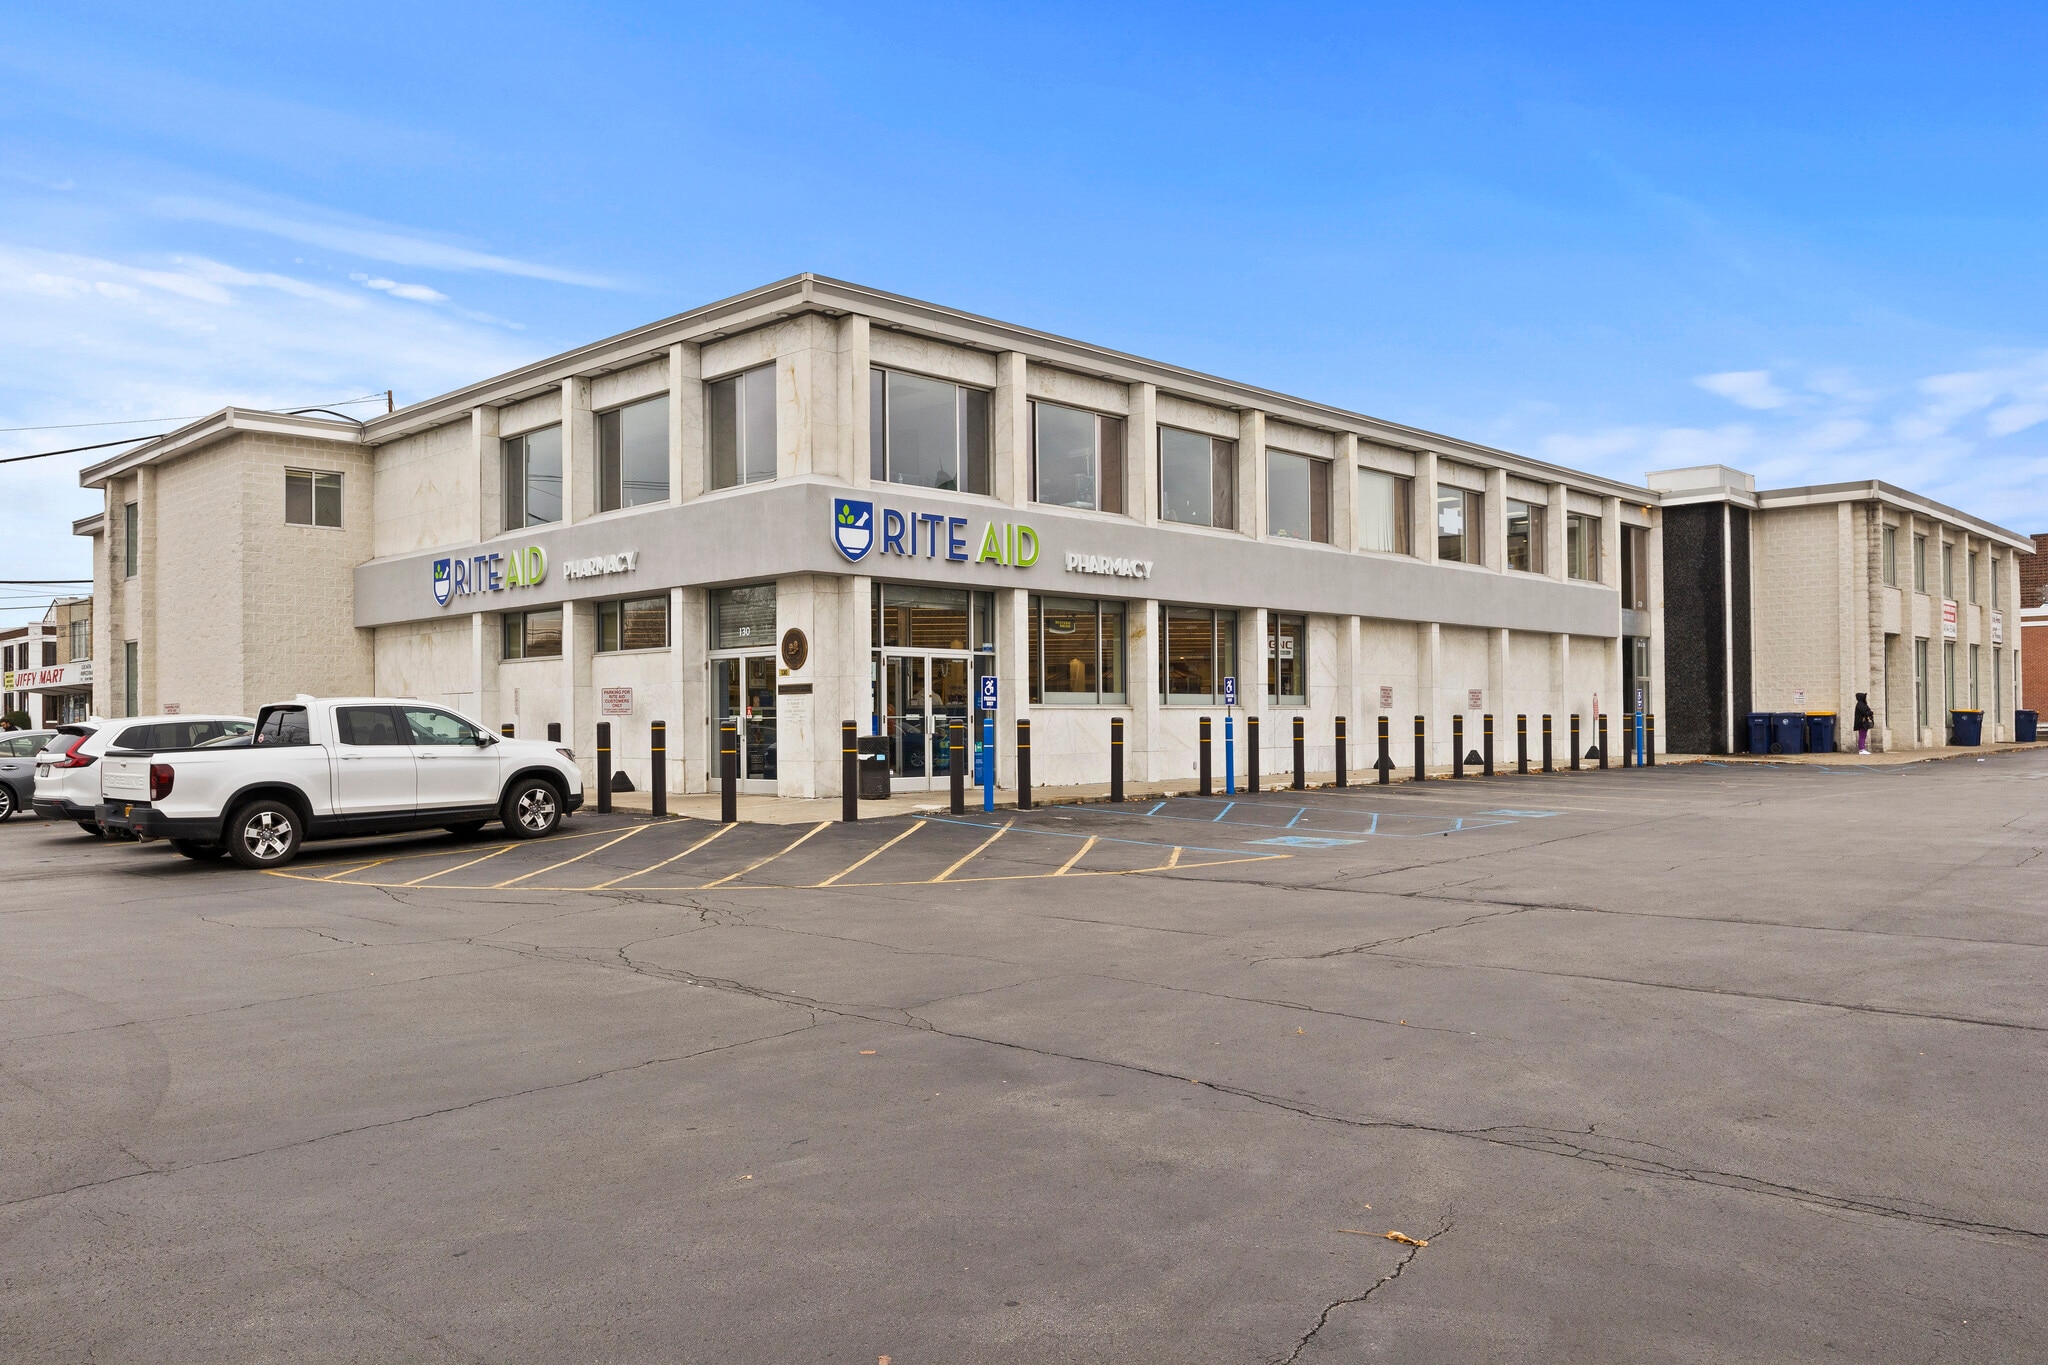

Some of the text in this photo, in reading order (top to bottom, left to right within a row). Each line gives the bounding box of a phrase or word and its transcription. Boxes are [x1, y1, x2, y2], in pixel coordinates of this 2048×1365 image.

[882, 508, 1040, 567] RITE AID
[454, 546, 547, 595] RITE AID
[563, 551, 639, 580] PHARMACY
[1065, 552, 1153, 578] PHARMACY
[739, 627, 750, 636] 130
[1269, 640, 1293, 649] GNC
[15, 672, 37, 687] JIFFY
[39, 668, 65, 684] MART
